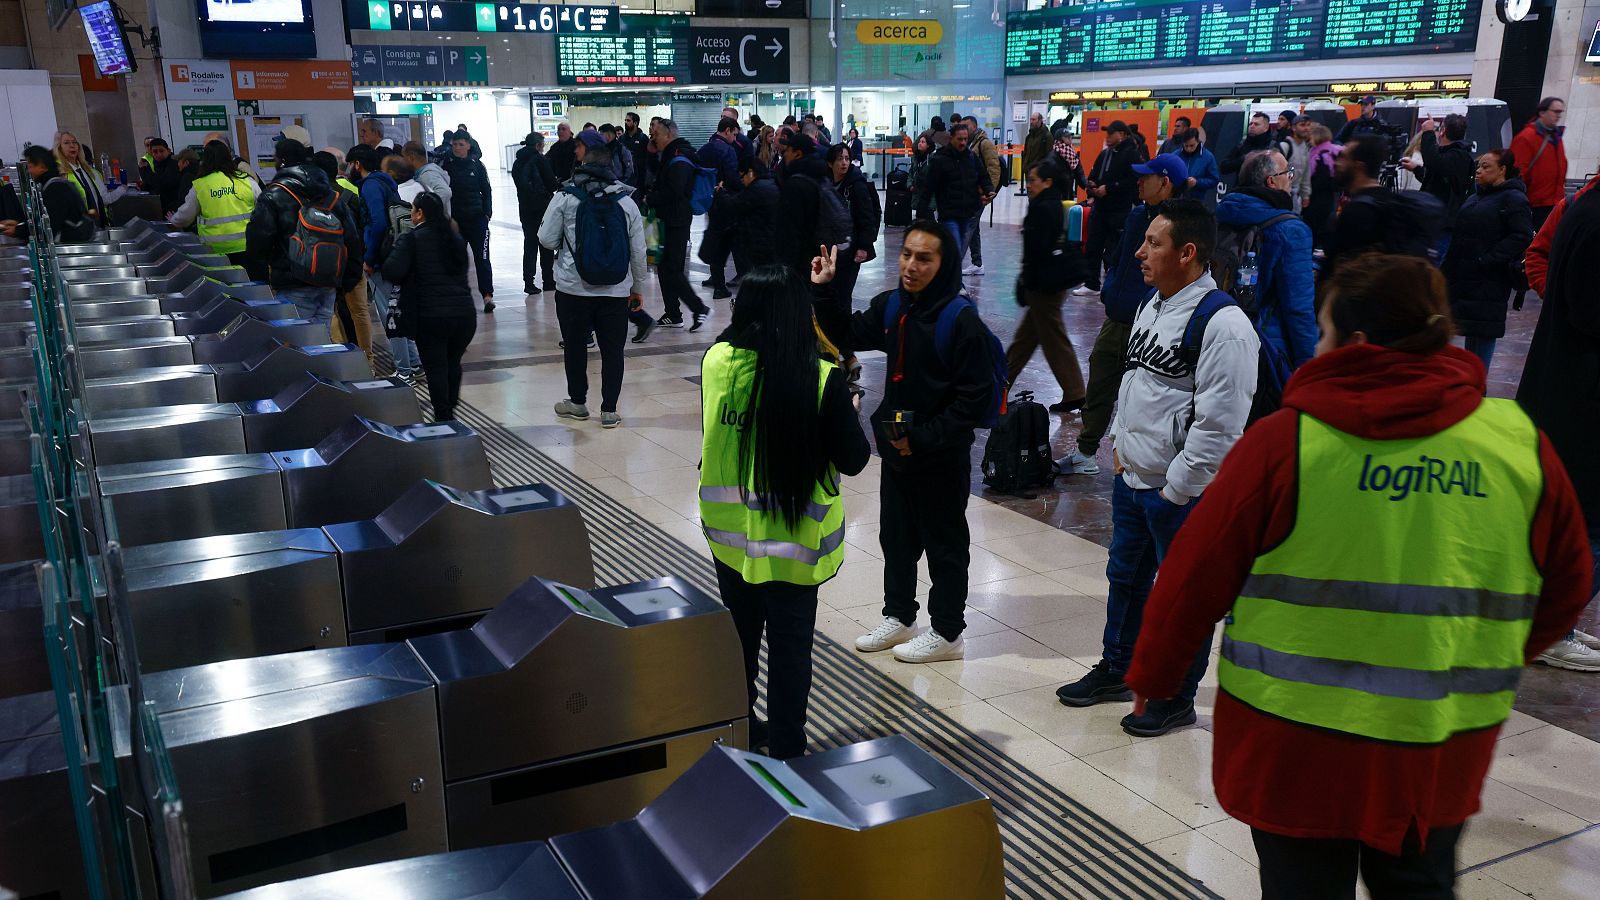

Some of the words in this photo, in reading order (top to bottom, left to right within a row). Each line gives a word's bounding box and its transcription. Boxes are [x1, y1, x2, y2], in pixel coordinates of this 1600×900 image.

[590, 8, 609, 16] Acceso
[574, 8, 586, 31] C
[873, 25, 927, 38] acerca
[696, 36, 731, 48] Acceso
[385, 49, 421, 63] Consigna
[702, 52, 732, 64] Accés
[739, 34, 758, 77] C
[924, 52, 941, 61] adif
[191, 71, 225, 79] Rodalies
[710, 69, 732, 77] ACCESS
[193, 87, 215, 95] renfe
[1358, 454, 1488, 501] logiRAIL
